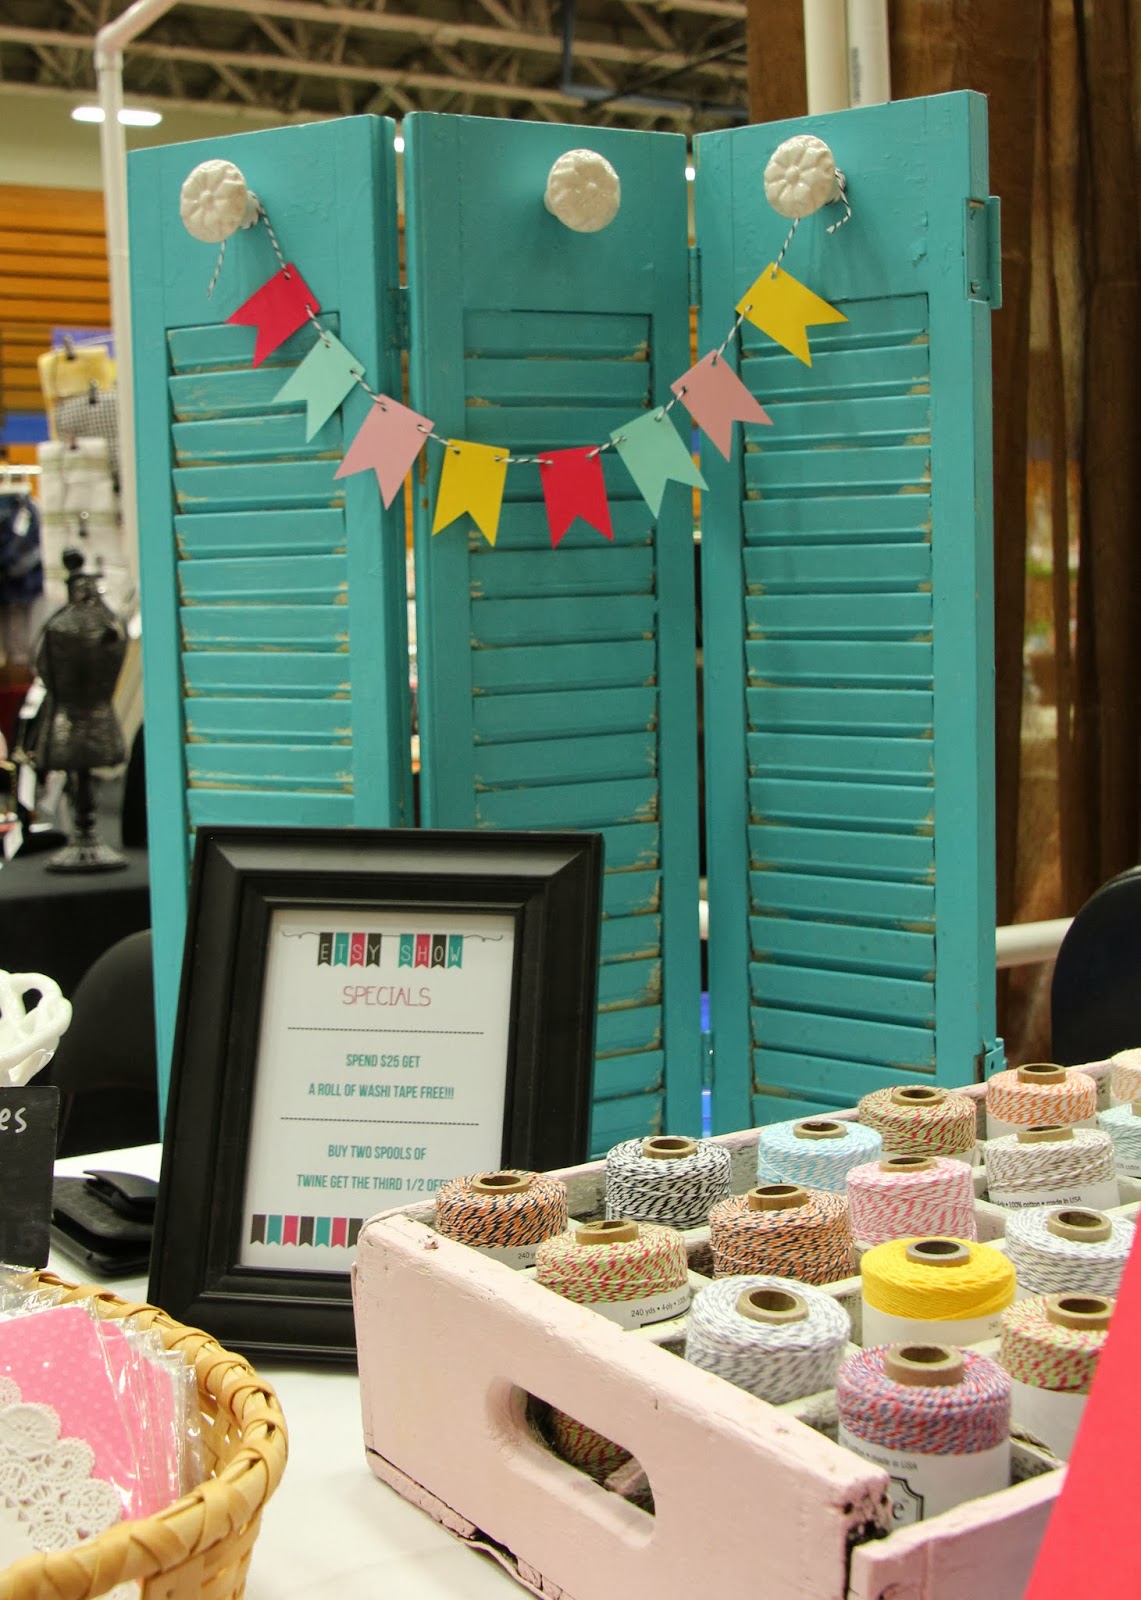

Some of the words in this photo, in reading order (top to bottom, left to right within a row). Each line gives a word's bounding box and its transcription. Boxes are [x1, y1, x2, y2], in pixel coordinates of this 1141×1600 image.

[320, 943, 380, 961] ETSY
[400, 944, 461, 962] SHOW
[342, 985, 432, 1007] SPECIALS
[346, 1053, 378, 1067] SPEND
[381, 1055, 400, 1068] $25
[402, 1055, 421, 1069] GET
[308, 1083, 315, 1096] A
[317, 1083, 341, 1097] ROLL
[344, 1084, 357, 1097] OF
[359, 1085, 391, 1098] WASHI
[394, 1085, 418, 1099] TAPE
[420, 1086, 455, 1100] FREE!!!
[328, 1144, 348, 1158] BUY
[350, 1145, 372, 1159] TWO
[374, 1146, 412, 1160] SPOOLS
[414, 1147, 427, 1160] OF
[297, 1174, 328, 1188] TWINE
[330, 1175, 349, 1189] GET
[351, 1176, 370, 1190] THE
[373, 1177, 403, 1191] THIRD
[406, 1178, 424, 1192] 1/2
[517, 1252, 530, 1260] 240
[631, 1308, 645, 1318] 240
